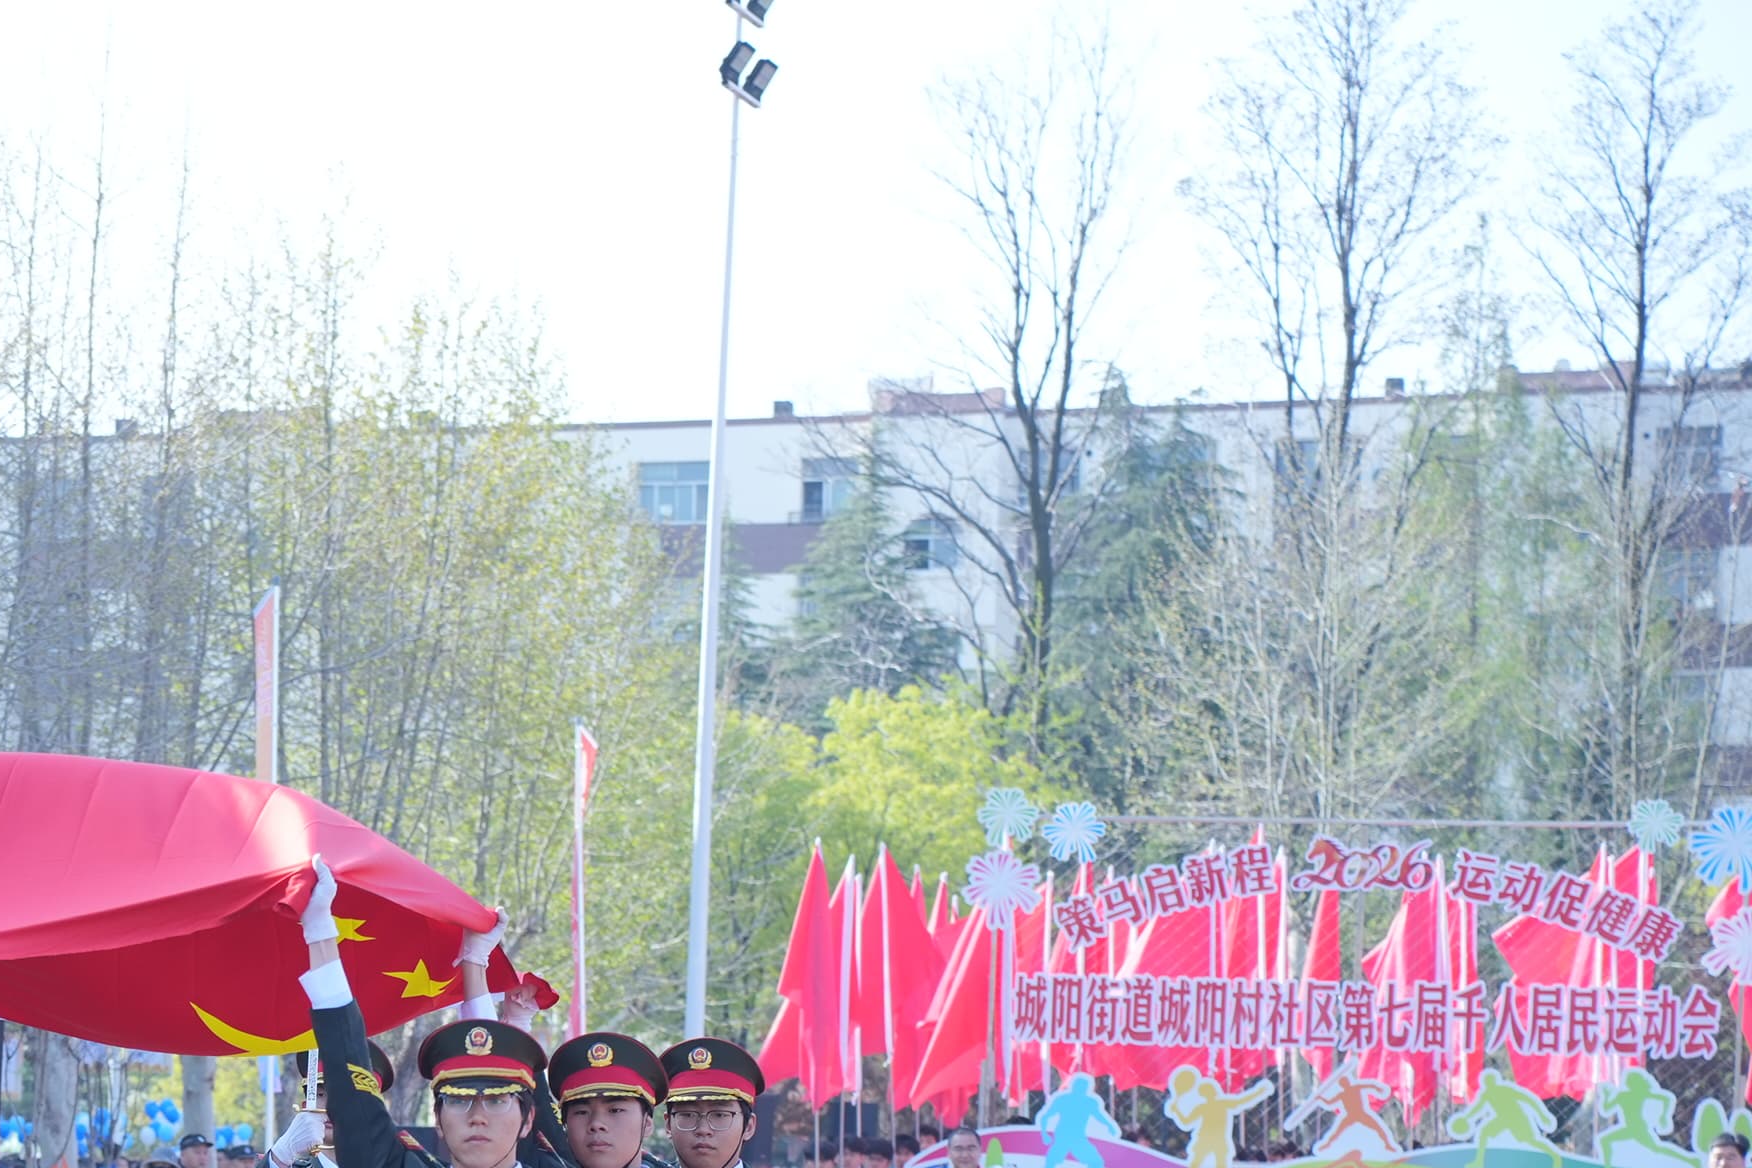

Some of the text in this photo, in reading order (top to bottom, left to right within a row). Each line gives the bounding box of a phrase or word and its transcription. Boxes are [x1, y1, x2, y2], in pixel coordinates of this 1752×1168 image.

[1056, 838, 1680, 960] 策马启新程 2026 运动促健康
[1014, 975, 1718, 1056] 城阳街道城阳村社区第七届千人居民运动会
